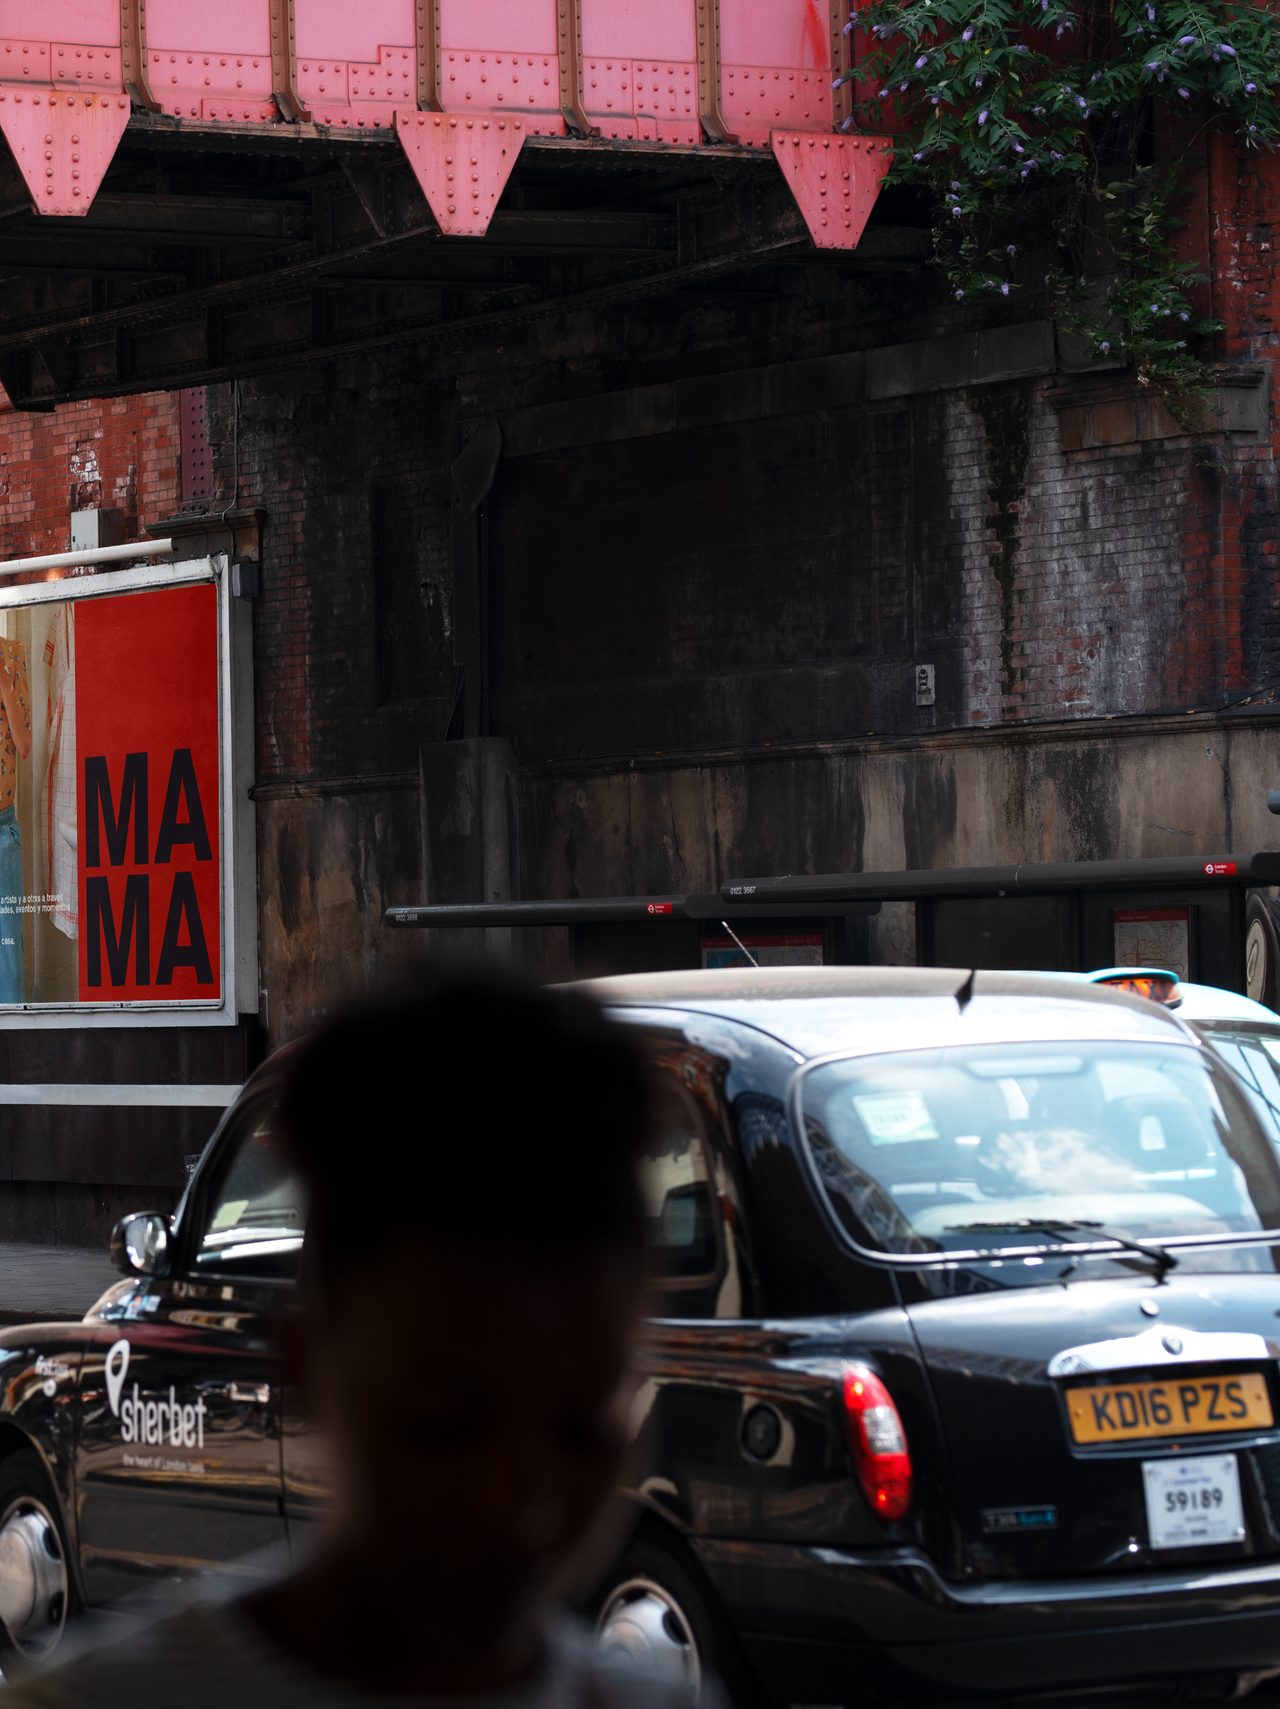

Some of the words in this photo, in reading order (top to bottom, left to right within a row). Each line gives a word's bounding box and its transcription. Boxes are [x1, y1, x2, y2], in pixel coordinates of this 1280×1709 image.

[84, 748, 213, 868] MA
[86, 871, 215, 987] MA
[121, 1382, 207, 1449] sherbet
[1090, 1388, 1172, 1431] KD16
[1179, 1382, 1248, 1423] PZS
[1166, 1488, 1223, 1513] 59189
